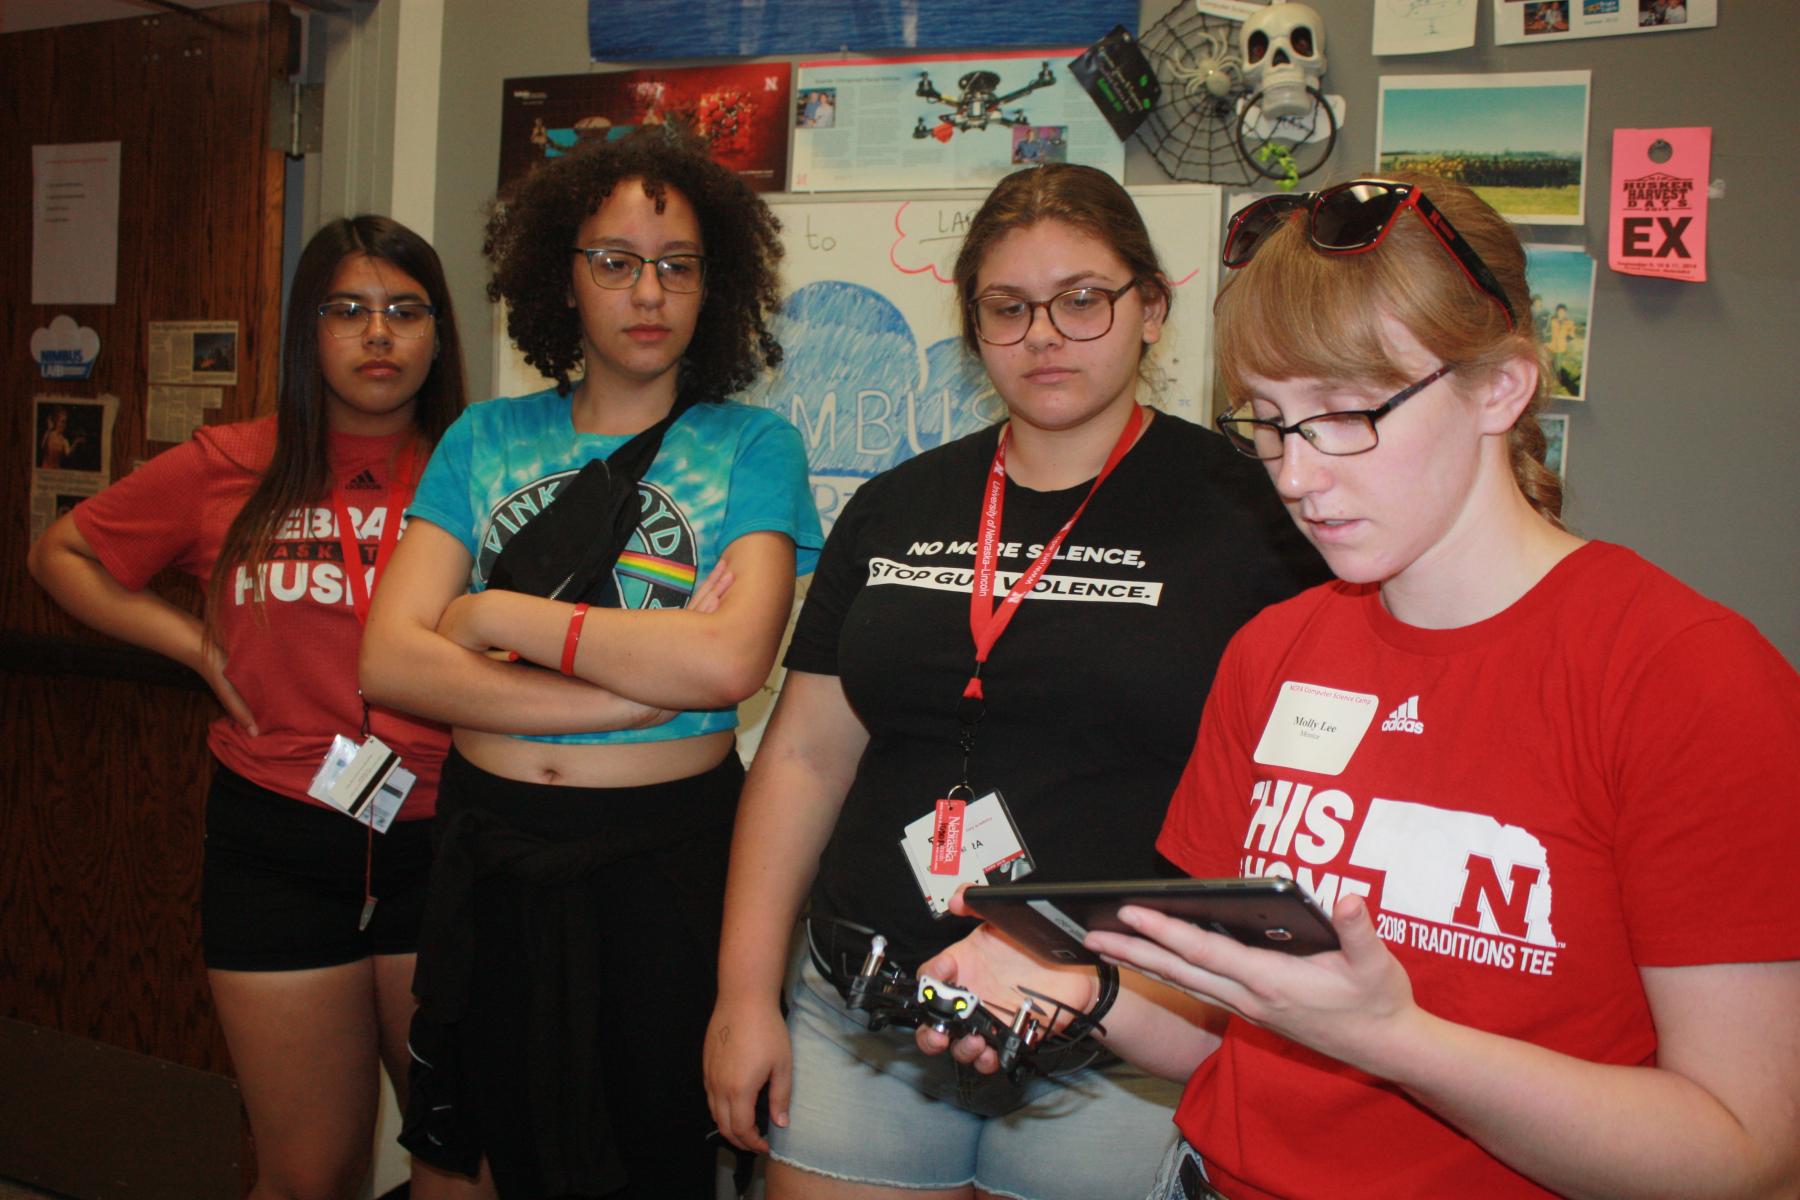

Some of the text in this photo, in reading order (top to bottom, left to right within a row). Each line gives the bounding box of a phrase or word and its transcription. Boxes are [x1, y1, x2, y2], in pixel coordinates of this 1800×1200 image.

[764, 76, 779, 91] N
[1623, 181, 1694, 192] HUSKER
[1628, 189, 1688, 200] HARVEST
[805, 213, 837, 251] to
[1622, 217, 1694, 259] EX
[41, 350, 83, 362] NIMBUS
[986, 480, 1001, 519] University
[986, 519, 997, 529] of
[907, 541, 944, 556] NO
[1026, 543, 1146, 569] SLENCE,
[872, 561, 931, 580] STOP
[1003, 577, 1151, 599] VOLENCE.
[1304, 687, 1333, 697] Computer
[1333, 692, 1354, 702] Science
[1355, 697, 1372, 705] Camp
[1293, 716, 1337, 733] Molly Lee
[1382, 717, 1424, 735] adidas
[944, 815, 961, 862] Nebraska
[1452, 852, 1542, 942] N
[1375, 913, 1557, 976] 2018 TRADITIONS TEE
